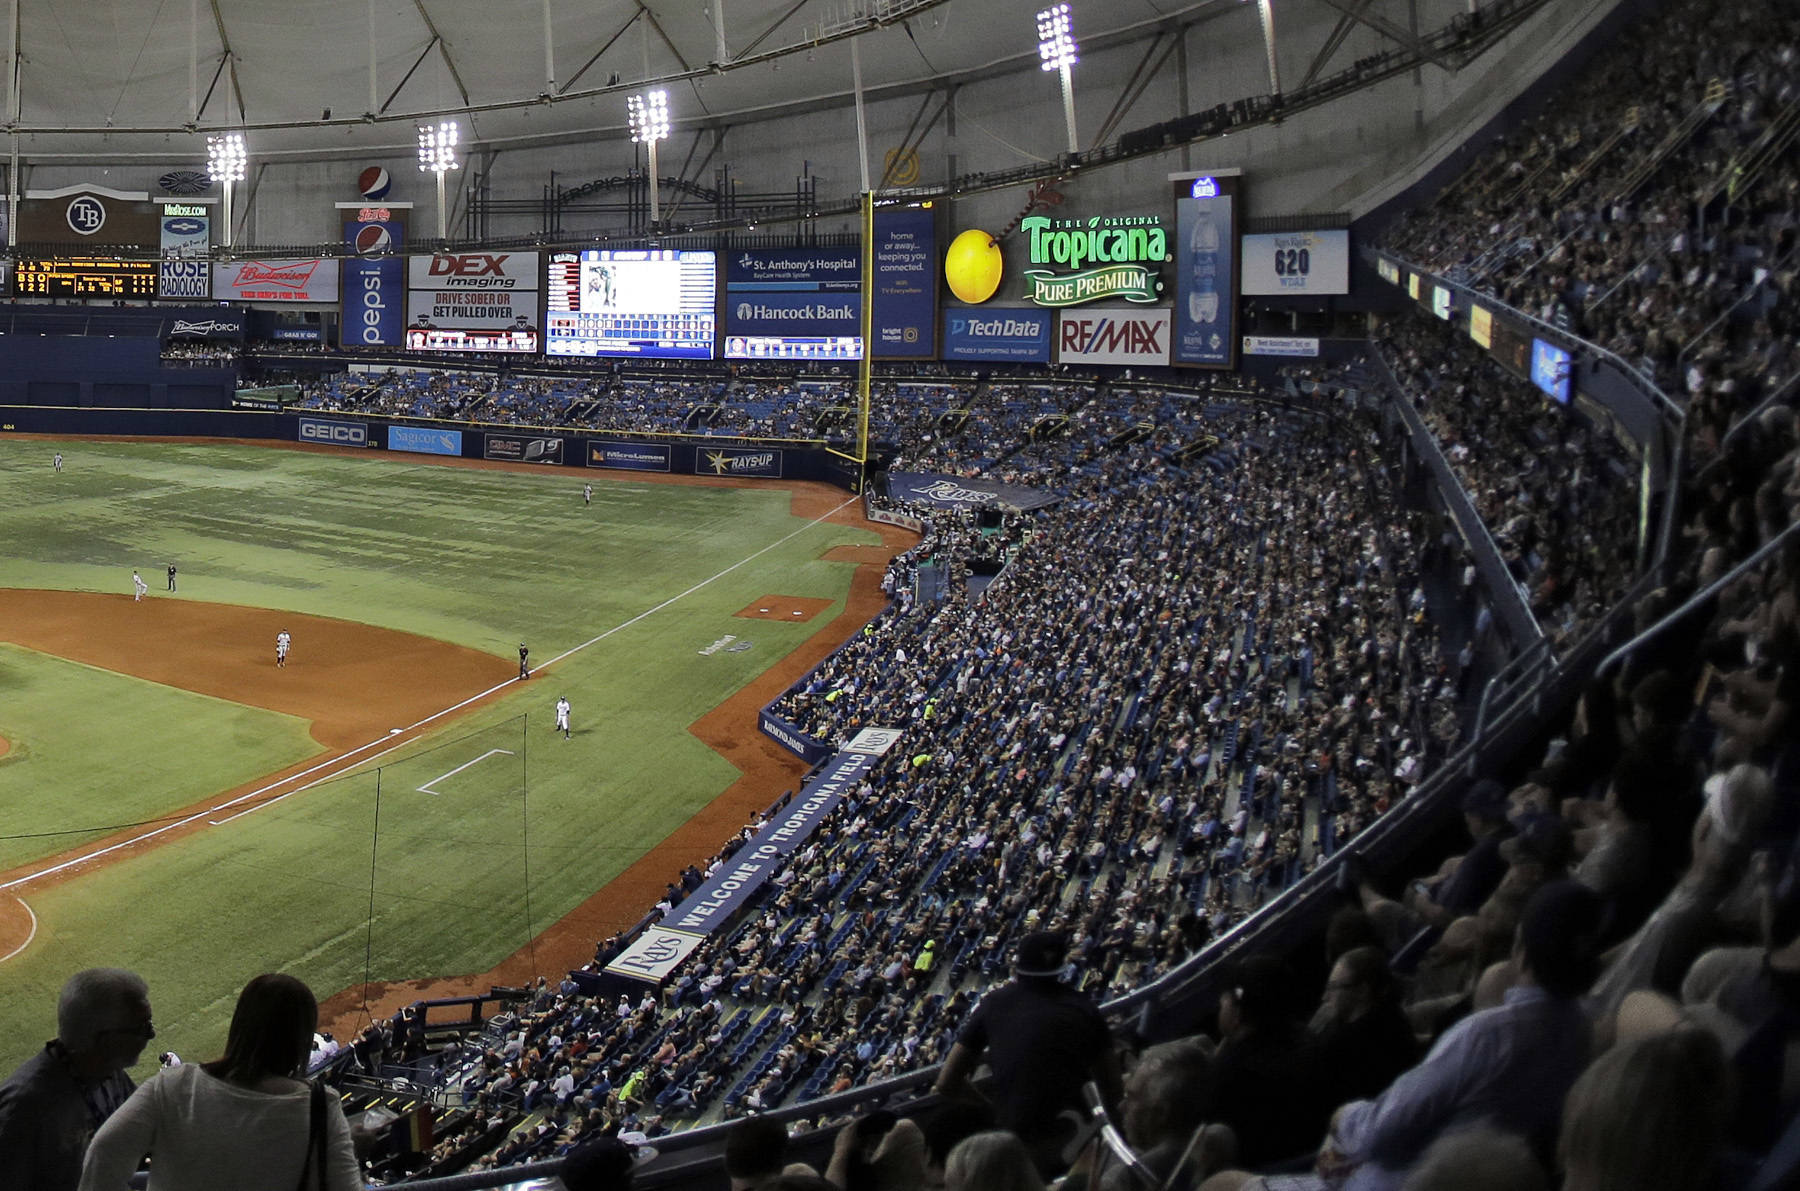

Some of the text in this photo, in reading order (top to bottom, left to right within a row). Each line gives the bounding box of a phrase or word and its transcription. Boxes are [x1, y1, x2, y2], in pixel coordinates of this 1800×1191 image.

[74, 204, 99, 227] TB
[1055, 216, 1160, 228] THE ORIGINAL
[890, 232, 914, 240] home
[1020, 216, 1167, 269] Tropicana
[428, 254, 510, 276] DEX
[753, 258, 856, 272] St. Anthony's Hospital
[878, 253, 926, 262] keeping you
[1274, 249, 1310, 276] 620
[161, 261, 207, 278] ROSE
[240, 265, 310, 281] Budweiser
[880, 262, 924, 271] connected.
[18, 274, 25, 282] B
[27, 274, 35, 282] S
[446, 276, 516, 288] imaging
[1034, 271, 1146, 301] PURE PREMIUM
[18, 283, 45, 292] 1 2 2
[161, 278, 207, 296] RADIOLOGY
[360, 269, 386, 344] pepsi
[435, 293, 510, 305] DRIVE SOBER OR
[433, 305, 513, 319] GET PULLED OVER
[753, 305, 853, 319] Hancock Bank
[210, 323, 240, 332] PORCH
[882, 328, 902, 336] bright
[968, 319, 1041, 337] Tech Data
[1061, 318, 1163, 355] RE/MAX
[301, 423, 365, 442] GEICO
[395, 428, 436, 447] Sagicor
[489, 439, 521, 451] GMC
[677, 754, 867, 927] WELCOME TO TROPICANA FIELD
[619, 936, 682, 972] RAYS
